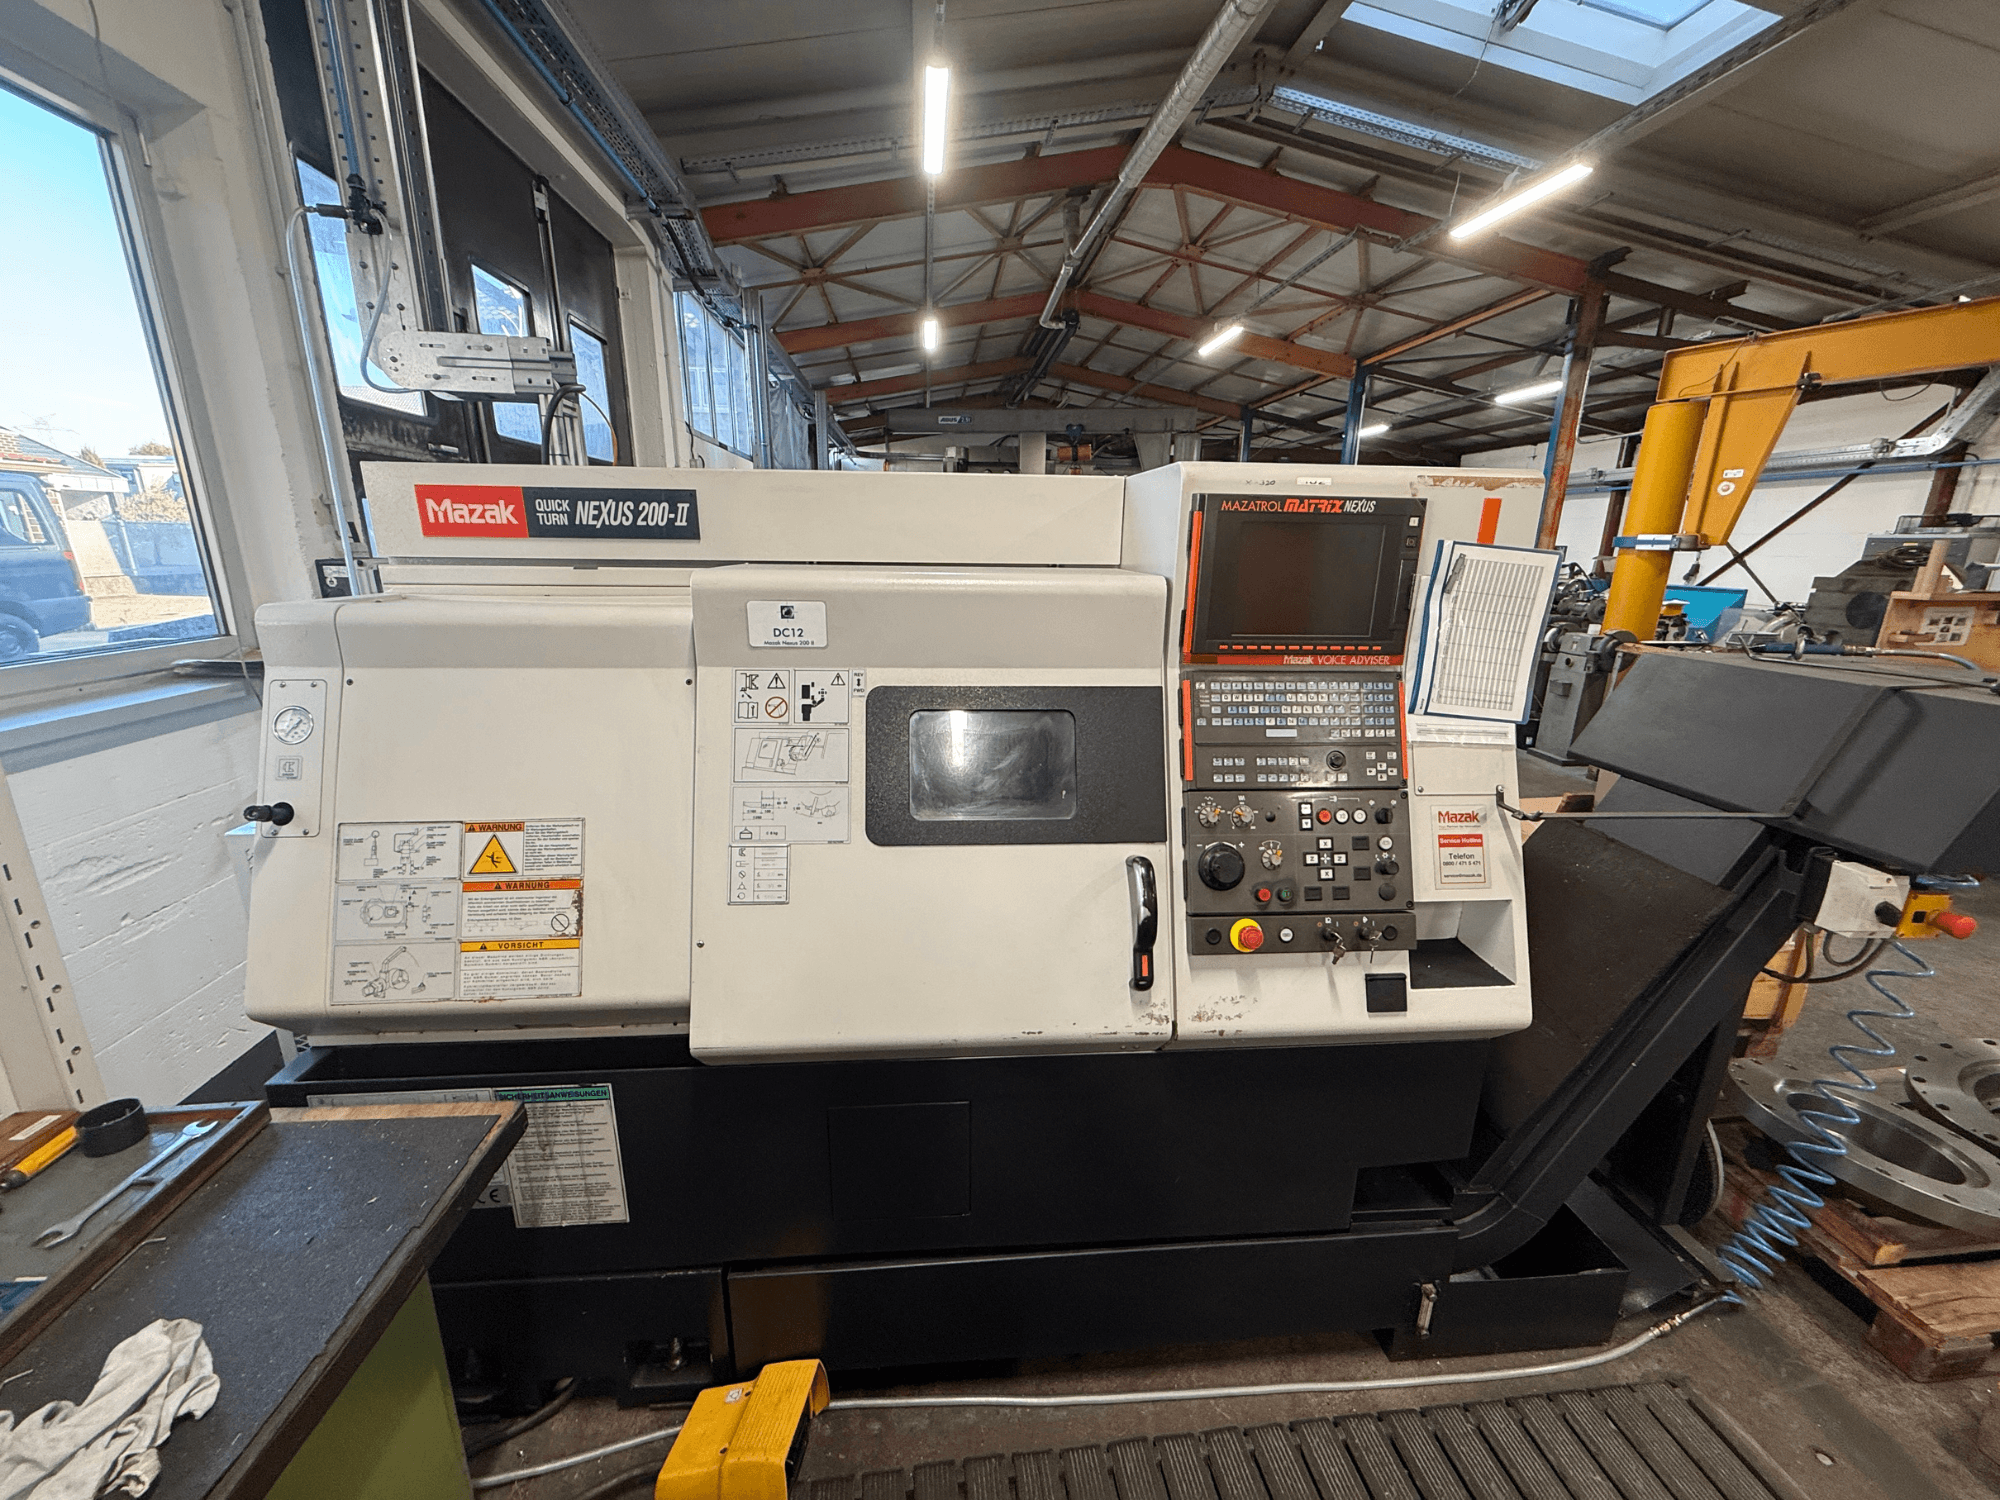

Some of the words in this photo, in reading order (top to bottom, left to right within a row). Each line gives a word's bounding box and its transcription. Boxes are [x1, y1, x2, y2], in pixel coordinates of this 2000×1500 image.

[425, 498, 519, 525] Mazak
[1221, 501, 1282, 513] MAZATROL
[1344, 499, 1376, 513] NEXUS
[535, 499, 570, 512] QUICK
[575, 499, 634, 528] NEXUS
[637, 502, 690, 526] 200-II
[536, 513, 568, 525] TURN
[773, 628, 804, 638] DC12
[1283, 655, 1314, 665] Mazak
[1317, 656, 1347, 665] VOICE
[1349, 656, 1390, 665] ADVISER
[1438, 811, 1480, 823] Mazak
[479, 823, 522, 831] WARNUNG
[505, 882, 550, 890] WARNUNG
[499, 1089, 607, 1100] SICHERHEITSANWEISUNGEN
